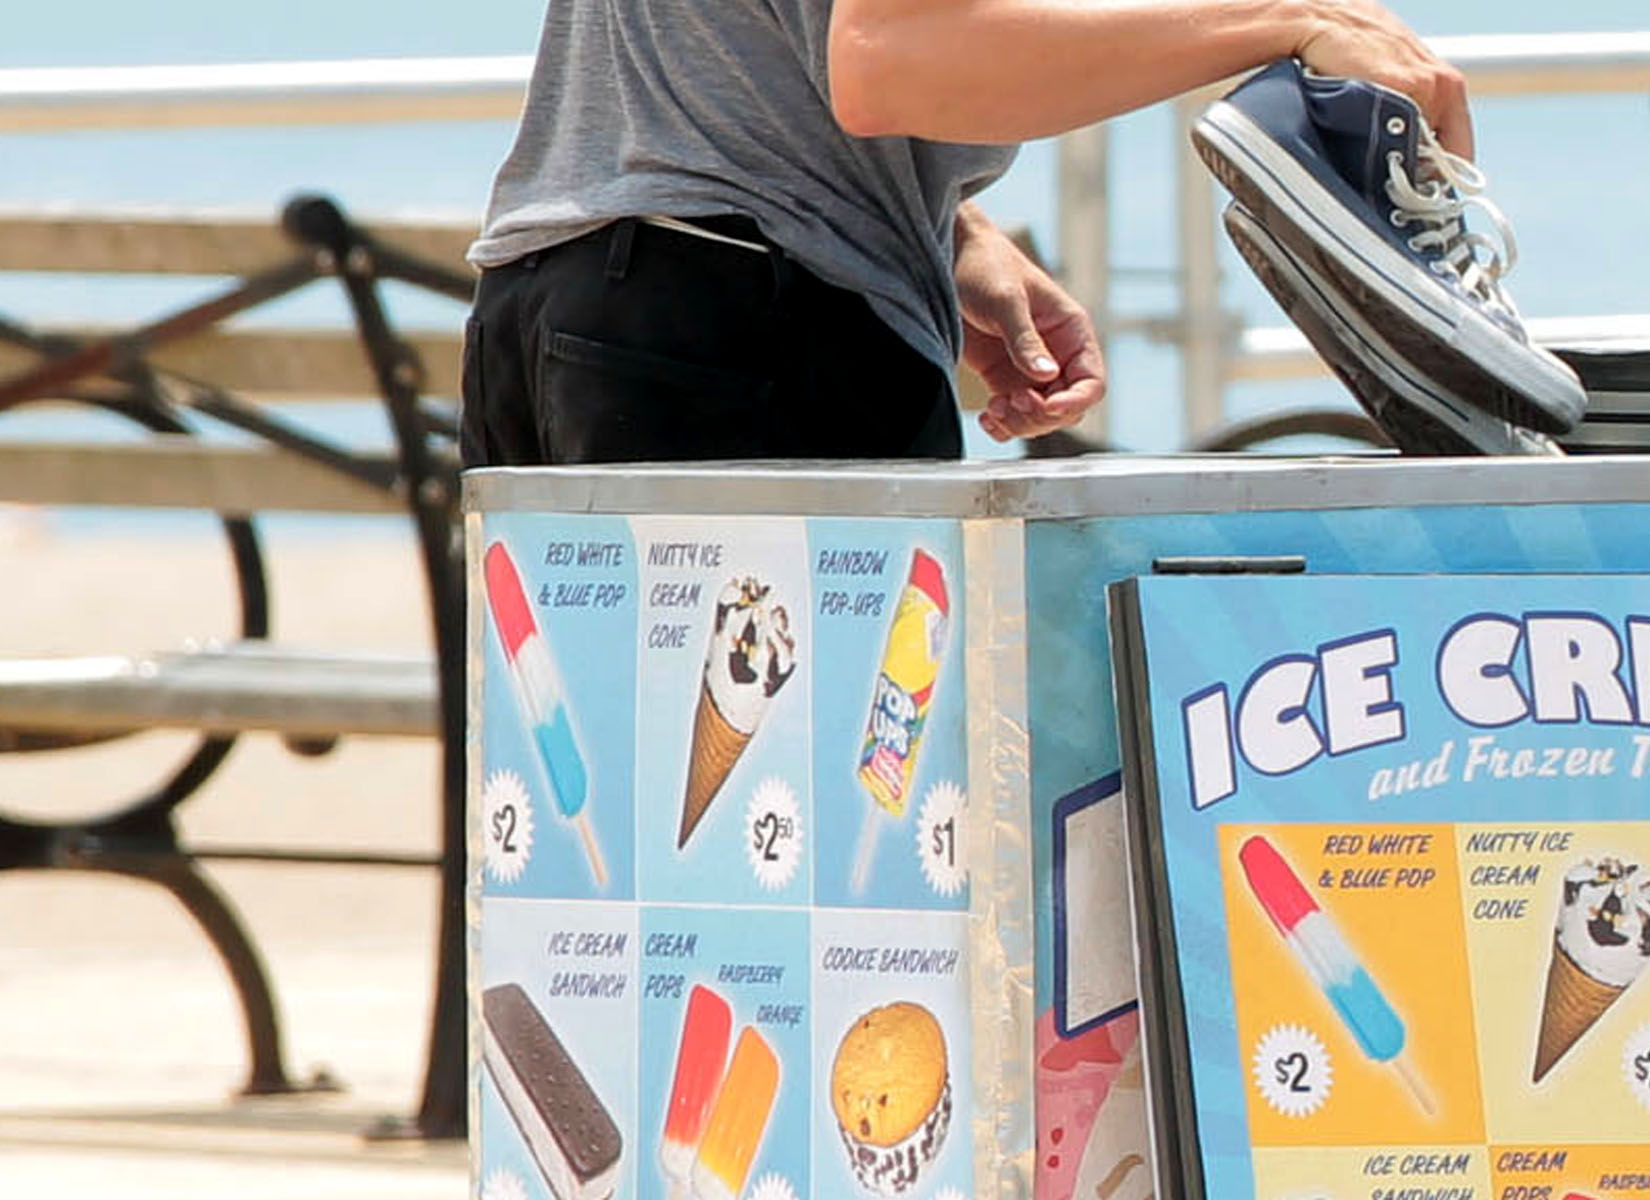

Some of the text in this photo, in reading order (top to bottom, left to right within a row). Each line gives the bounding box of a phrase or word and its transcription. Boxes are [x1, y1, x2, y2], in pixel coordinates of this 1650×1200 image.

[545, 542, 623, 567] RED WHITE
[647, 542, 722, 567] NUTTY ICE
[817, 548, 889, 574] RAINBOW
[538, 583, 626, 607] & BLUE POP
[649, 583, 700, 607] CREAM
[818, 590, 885, 615] POP-UPS
[648, 624, 690, 648] CONE
[1182, 628, 1405, 810] ICE
[1368, 747, 1450, 801] and
[1462, 735, 1613, 781] Frozen
[492, 804, 517, 853] $2
[932, 815, 955, 866] $1
[1323, 834, 1430, 856] RED WHITE
[1466, 832, 1572, 854] NUTTY ICE
[1318, 868, 1436, 889] & BLUE POP
[1470, 866, 1540, 888] CREAM
[1474, 900, 1527, 921] CONE
[548, 931, 627, 957] ICE CREAM
[645, 932, 697, 958] CREAM
[823, 946, 959, 974] COOKIE SANDWICH
[549, 973, 626, 999] SANDWICH
[644, 974, 682, 1000] POPS
[717, 964, 784, 986] RASPBERRY
[756, 1003, 804, 1025] ORANGE
[1275, 1052, 1311, 1091] $2
[1364, 1154, 1469, 1174] ICE CREAM
[1497, 1152, 1566, 1172] CREAM
[1502, 1186, 1553, 1200] POPS
